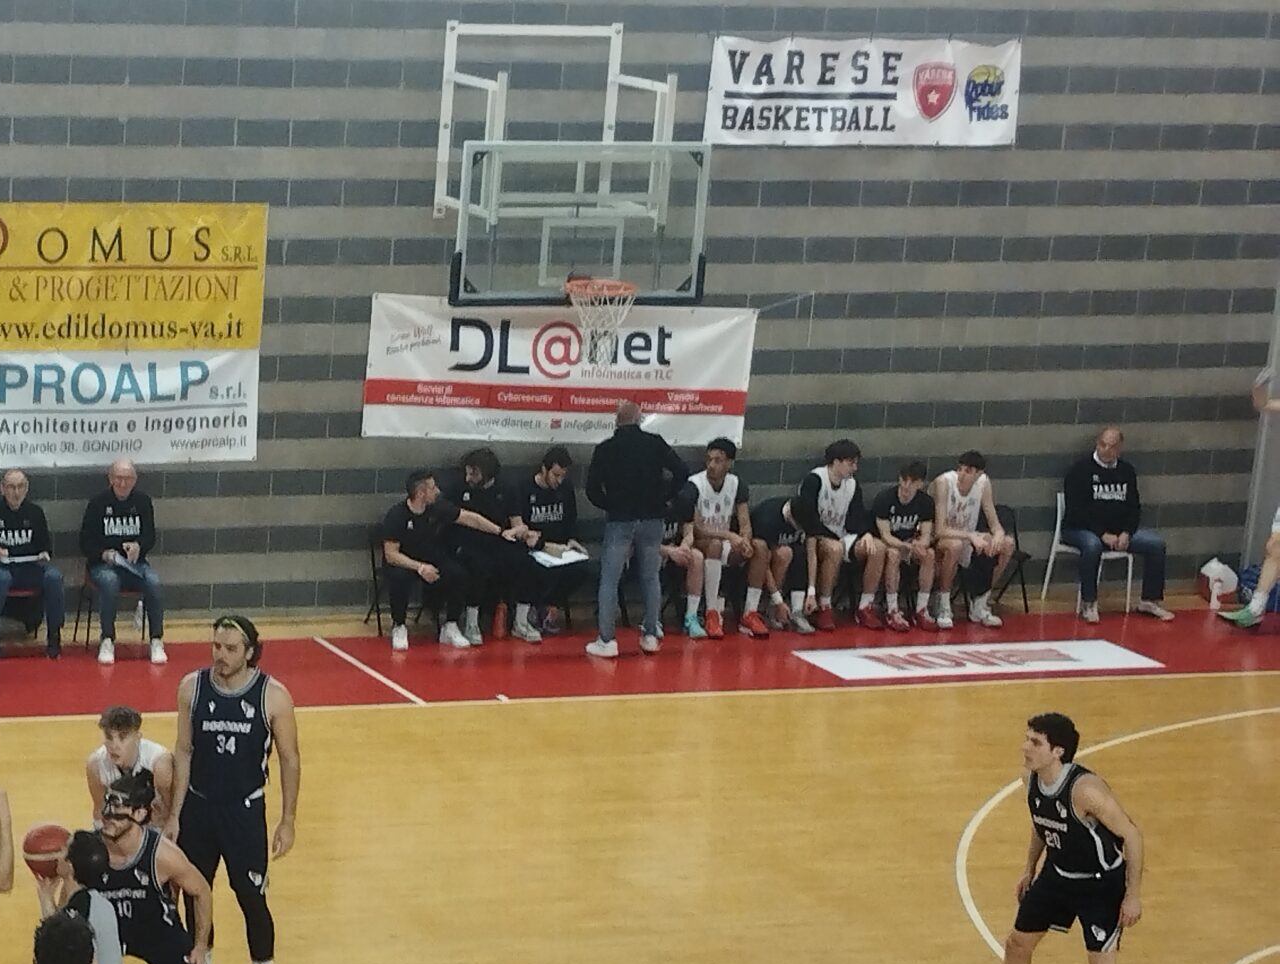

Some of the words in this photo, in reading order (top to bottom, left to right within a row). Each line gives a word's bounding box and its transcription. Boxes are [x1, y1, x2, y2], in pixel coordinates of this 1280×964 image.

[727, 49, 902, 86] VARESE
[721, 104, 897, 132] BASKETBALL
[8, 274, 29, 302] &
[35, 274, 239, 302] PROGETTAZIONI
[126, 419, 138, 433] e
[144, 410, 248, 434] Ingegneria
[0, 441, 17, 456] Via
[216, 733, 236, 755] 34
[1045, 830, 1062, 850] 20
[117, 900, 132, 919] 10
